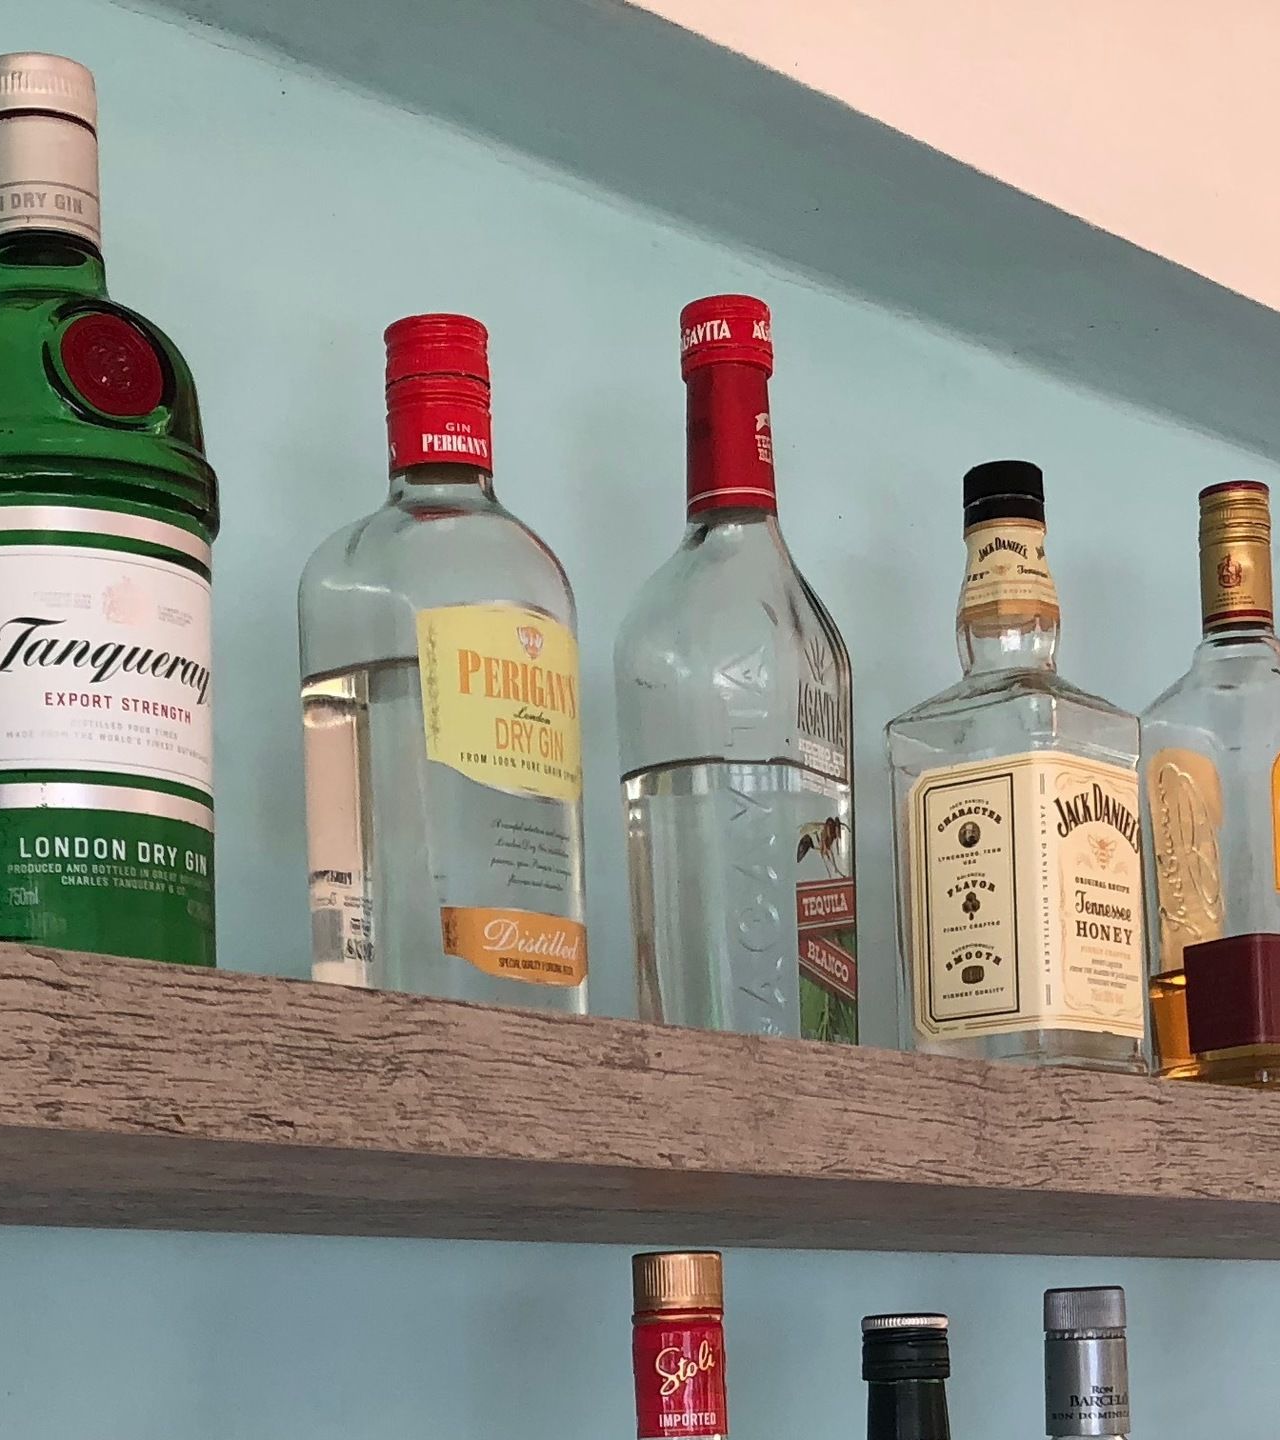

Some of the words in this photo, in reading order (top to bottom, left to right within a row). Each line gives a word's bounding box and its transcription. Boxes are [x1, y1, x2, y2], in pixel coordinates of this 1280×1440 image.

[10, 192, 47, 210] DRY
[55, 194, 84, 215] GIN
[445, 422, 471, 434] GIN
[422, 433, 488, 458] PERIGAN'S
[457, 649, 577, 720] PERIGAN'S
[44, 691, 113, 710] EXPORT
[121, 697, 192, 725] STRENGTH
[513, 706, 552, 725] London
[495, 716, 534, 754] DRY
[538, 726, 565, 763] GIN
[460, 751, 488, 764] FROM
[492, 754, 517, 768] 100%
[521, 759, 540, 772] PURE
[937, 806, 1003, 833] CHARACTER
[1053, 792, 1093, 838] JACK
[19, 836, 126, 861] LONDON
[137, 841, 178, 867] DRY
[184, 850, 208, 876] GIN
[7, 863, 62, 874] PRODUCED
[66, 864, 88, 874] AND
[91, 864, 137, 877] BOTTLED
[61, 875, 109, 887] CHARLES
[113, 878, 166, 892] TANQUERAY
[947, 880, 997, 898] FLAVOR
[802, 891, 849, 917] TEQUILA
[1074, 889, 1132, 922] Tennessee
[483, 918, 579, 960] Distilled
[1075, 920, 1133, 946] HONEY
[807, 939, 850, 983] BLANCO
[945, 950, 1003, 972] SMOOTH
[654, 1339, 716, 1397] Stoli
[659, 1411, 718, 1429] IMPORTED
